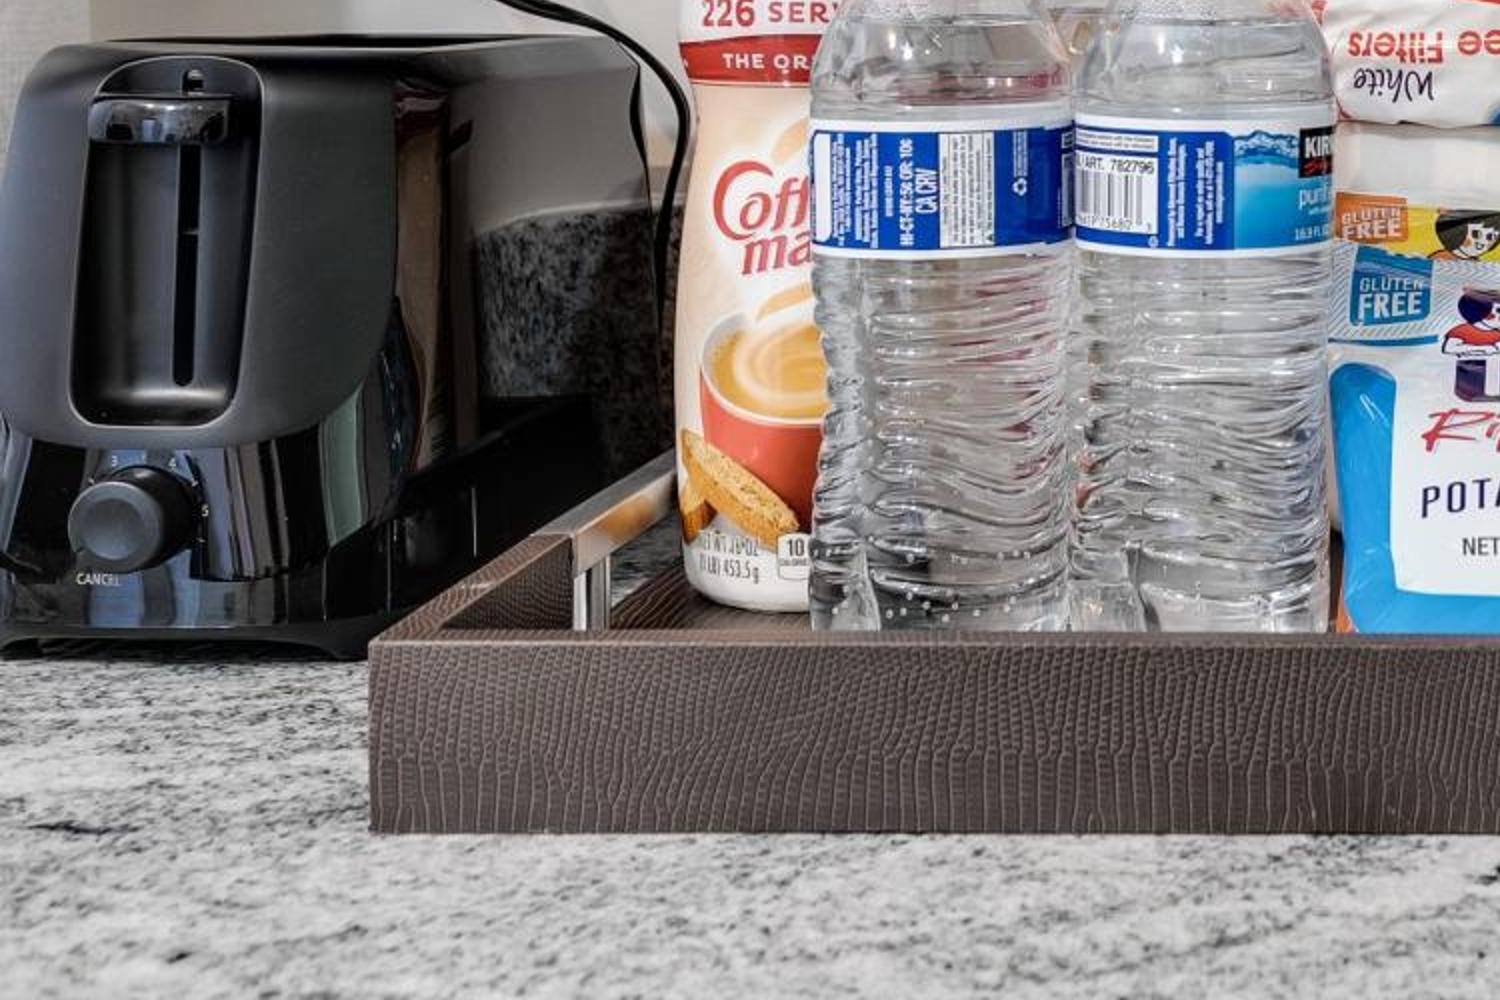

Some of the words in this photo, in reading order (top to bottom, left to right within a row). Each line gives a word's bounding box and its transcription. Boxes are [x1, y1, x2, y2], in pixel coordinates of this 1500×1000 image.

[1347, 31, 1444, 65] Filters
[721, 53, 765, 69] THE
[773, 53, 815, 70] OR
[1353, 68, 1434, 103] White
[914, 167, 937, 195] CRV
[915, 195, 937, 214] CA
[1343, 218, 1401, 241] FREE
[1359, 276, 1427, 293] GLUTEN
[1358, 291, 1423, 327] FREE
[111, 455, 118, 467] 3
[168, 457, 176, 470] 4
[201, 504, 209, 517] 5
[788, 537, 805, 557] 10
[1462, 537, 1500, 556] NET
[76, 573, 120, 585] CANCEL
